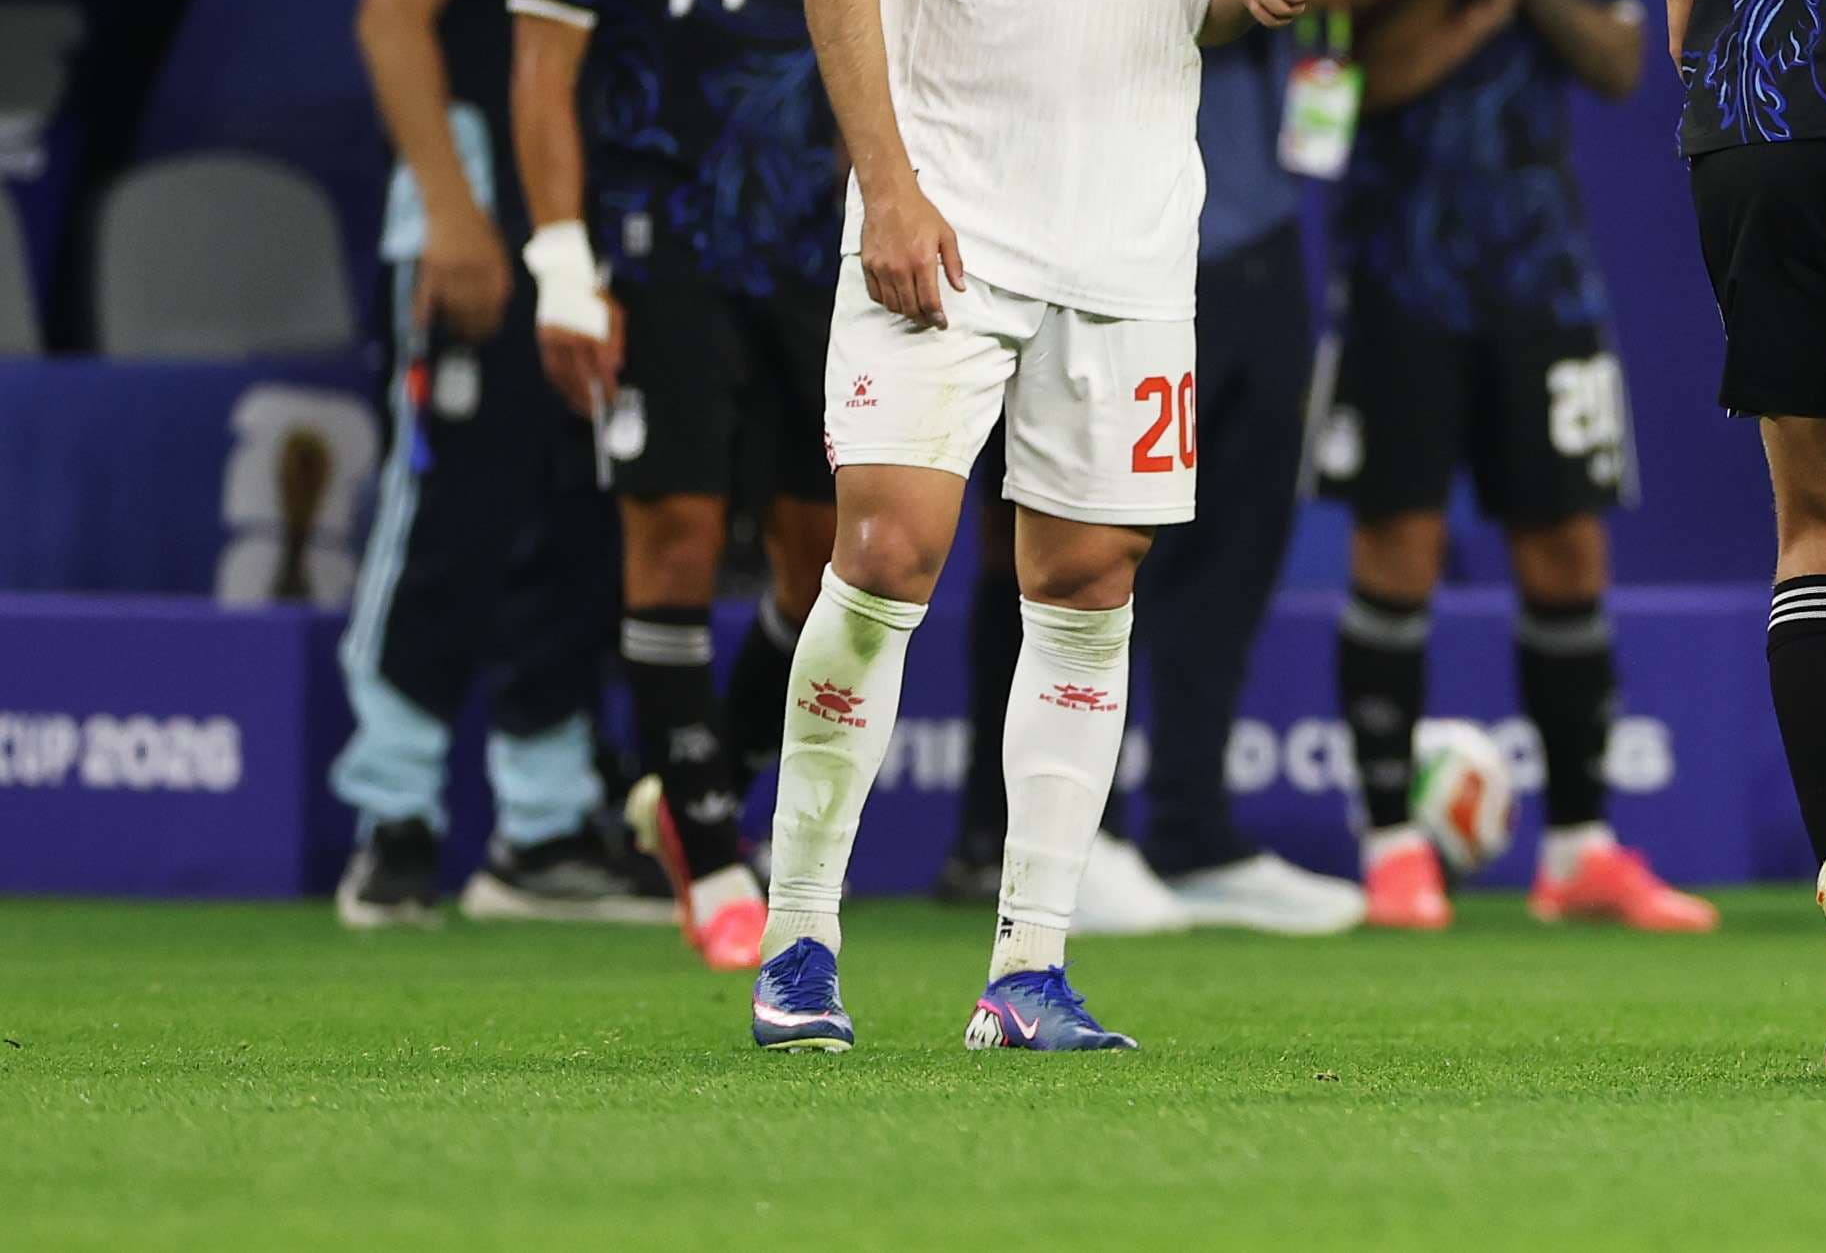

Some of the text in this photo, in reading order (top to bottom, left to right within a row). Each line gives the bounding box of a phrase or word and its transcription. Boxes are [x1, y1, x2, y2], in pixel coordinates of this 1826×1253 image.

[1132, 371, 1196, 473] 20
[797, 697, 866, 728] KELME
[1039, 692, 1118, 712] KELME
[80, 713, 244, 793] 2026
